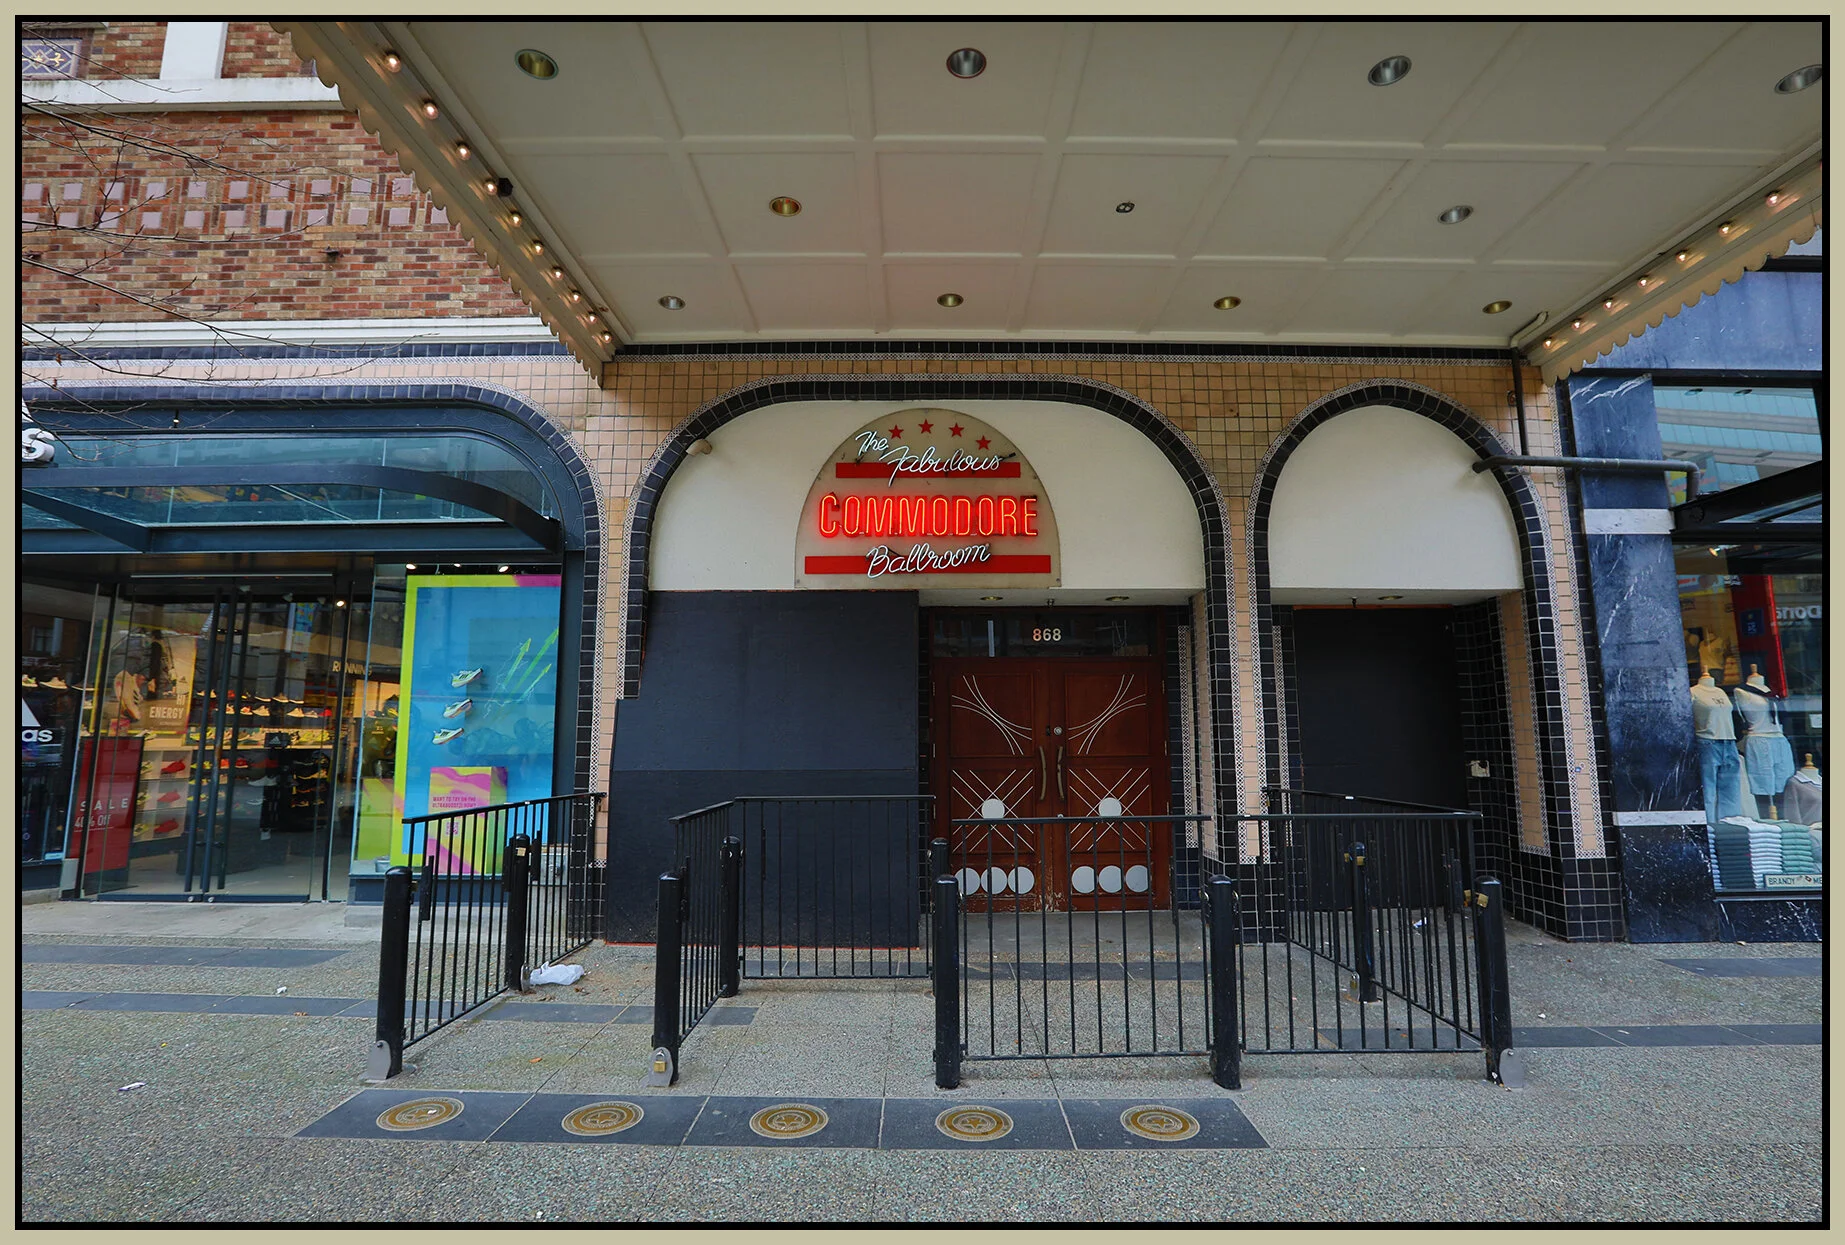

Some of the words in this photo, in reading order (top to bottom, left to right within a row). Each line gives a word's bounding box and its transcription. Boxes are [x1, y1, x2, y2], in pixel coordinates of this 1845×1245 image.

[855, 430, 889, 456] The
[878, 445, 1002, 488] Fabulous
[819, 493, 1039, 538] COMMODORE
[865, 542, 992, 579] Ballroom
[1032, 628, 1062, 641] 868
[332, 660, 373, 677] RNNING
[149, 706, 185, 719] ENERGY
[22, 729, 54, 742] as
[80, 798, 129, 812] SALE
[1768, 877, 1796, 885] BRANDY
